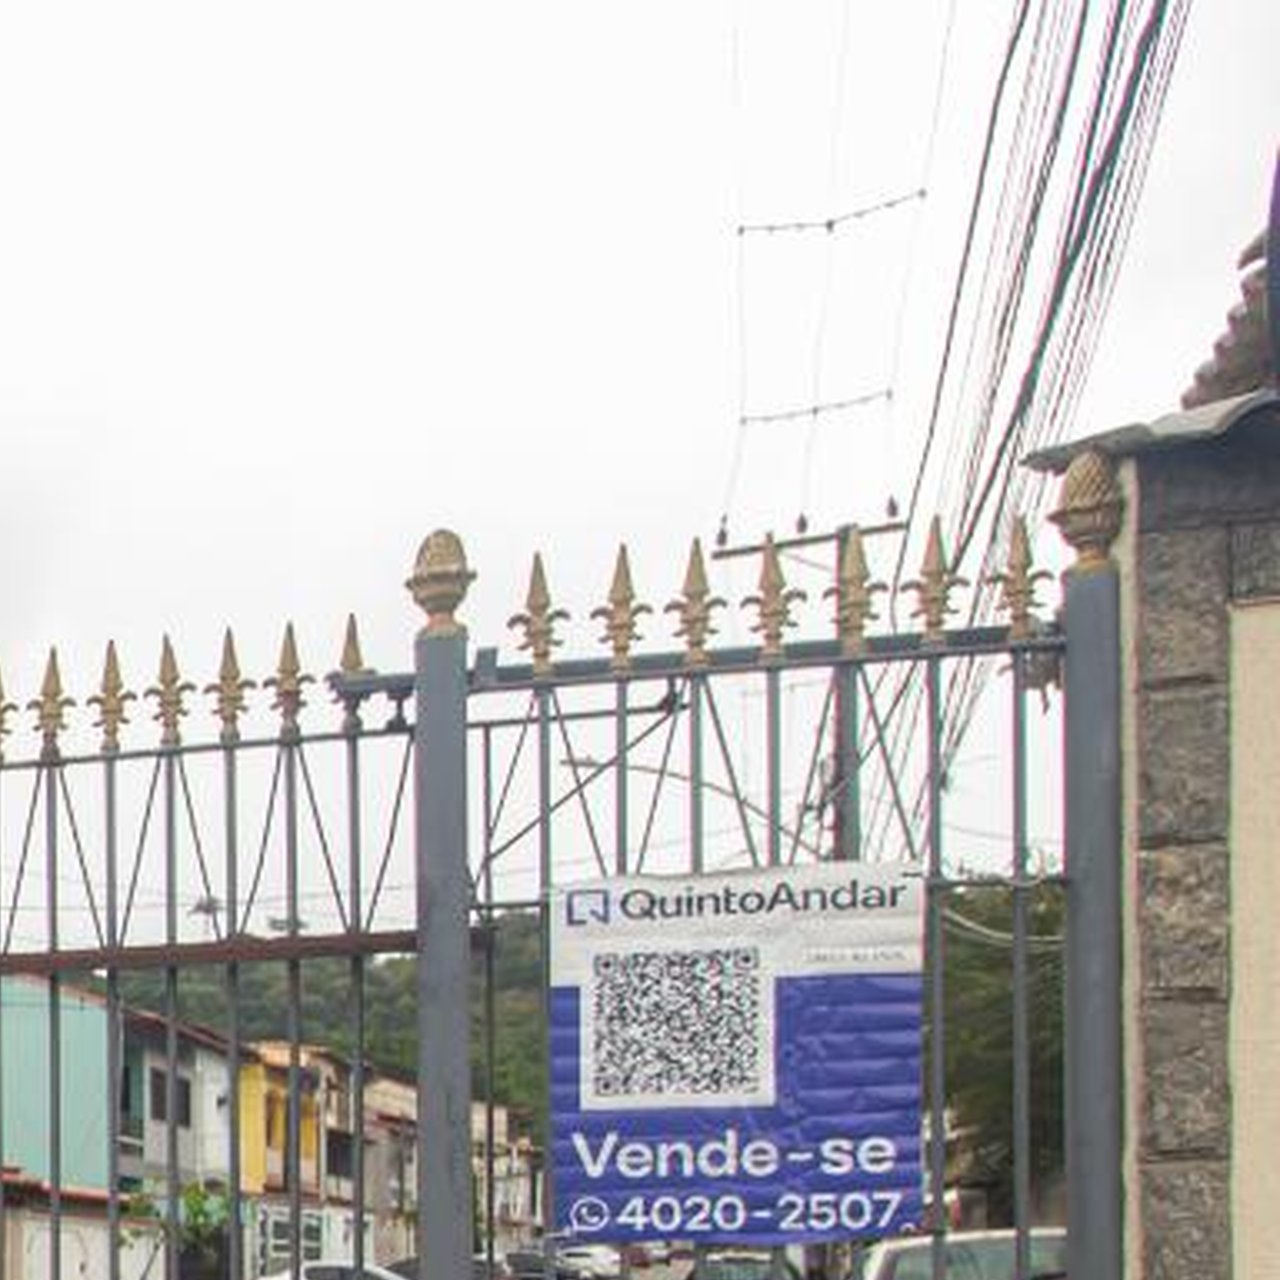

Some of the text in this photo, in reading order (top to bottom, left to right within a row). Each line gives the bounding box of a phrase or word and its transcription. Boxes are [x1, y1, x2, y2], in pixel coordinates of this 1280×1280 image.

[621, 880, 906, 922] QuintoAndar
[572, 1130, 898, 1178] Vende-se
[616, 1192, 903, 1232] 4020-2507
